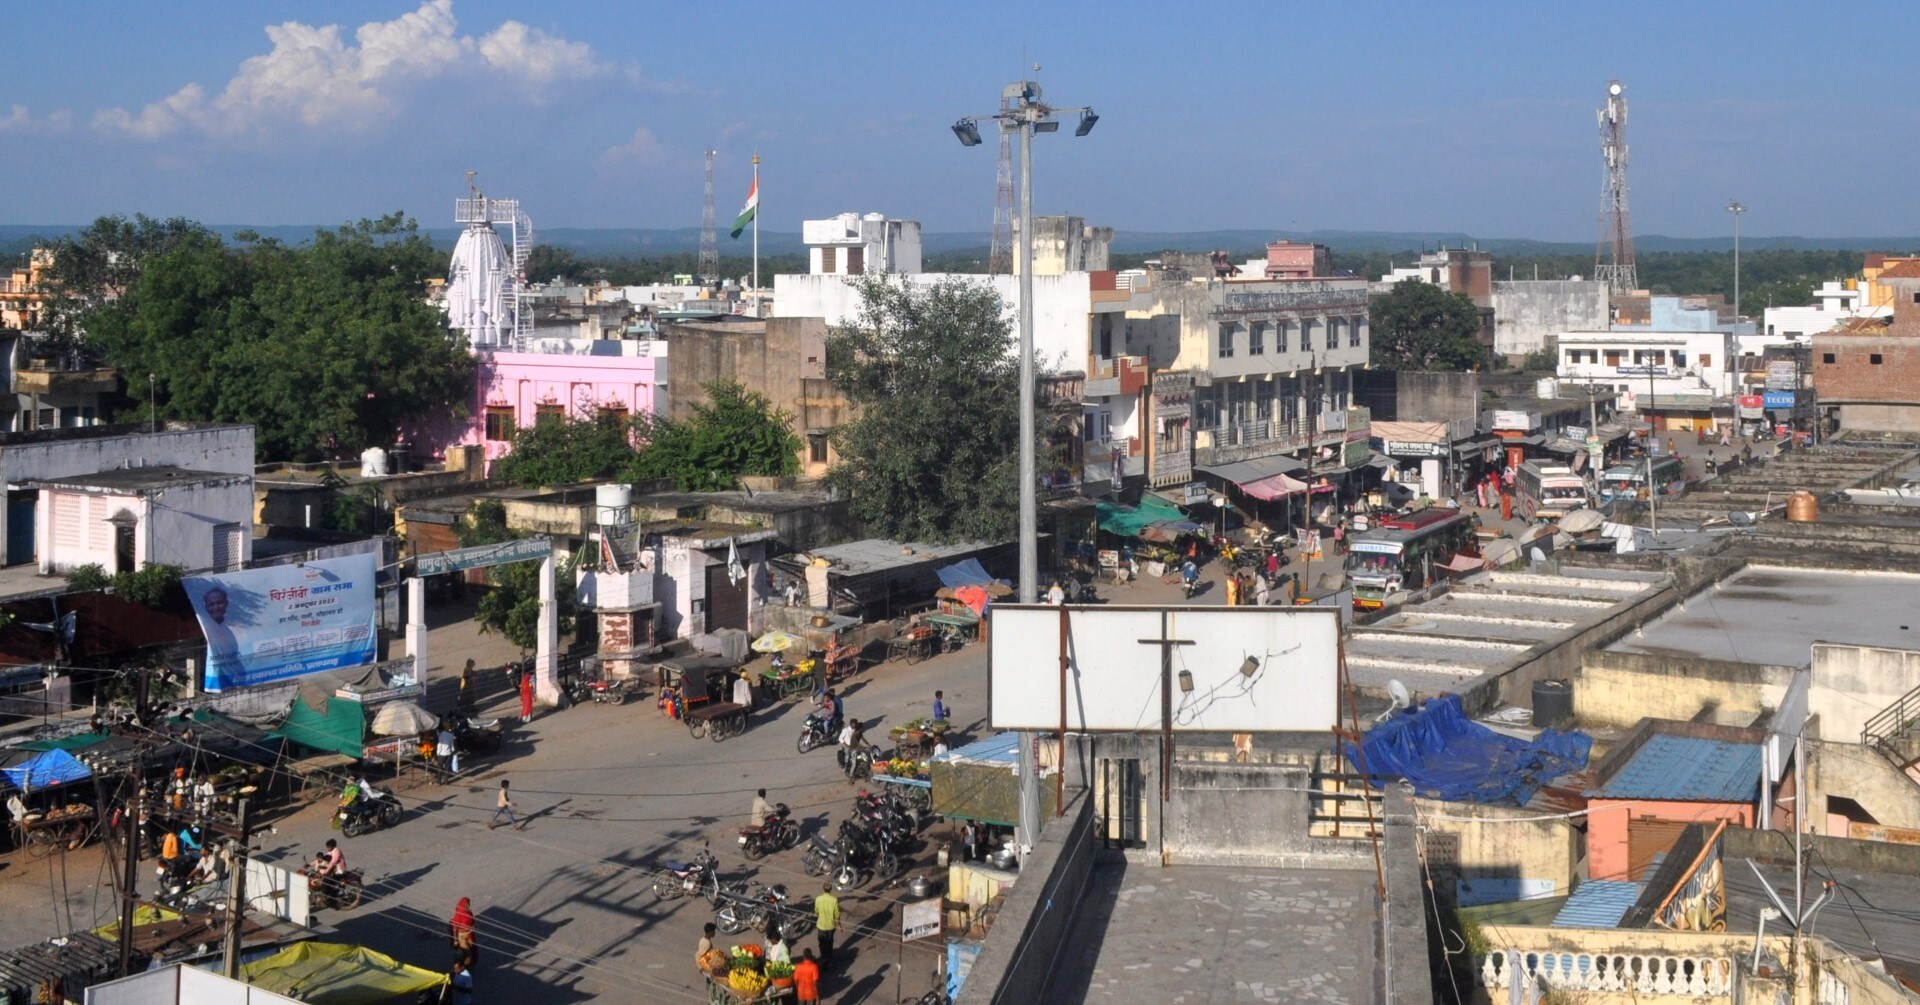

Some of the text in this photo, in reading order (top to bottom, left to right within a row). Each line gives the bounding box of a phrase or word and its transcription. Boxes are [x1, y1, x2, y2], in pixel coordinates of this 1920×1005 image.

[269, 582, 353, 600] चिरंजीवी ग्राम सभा
[318, 598, 335, 606] 2022
